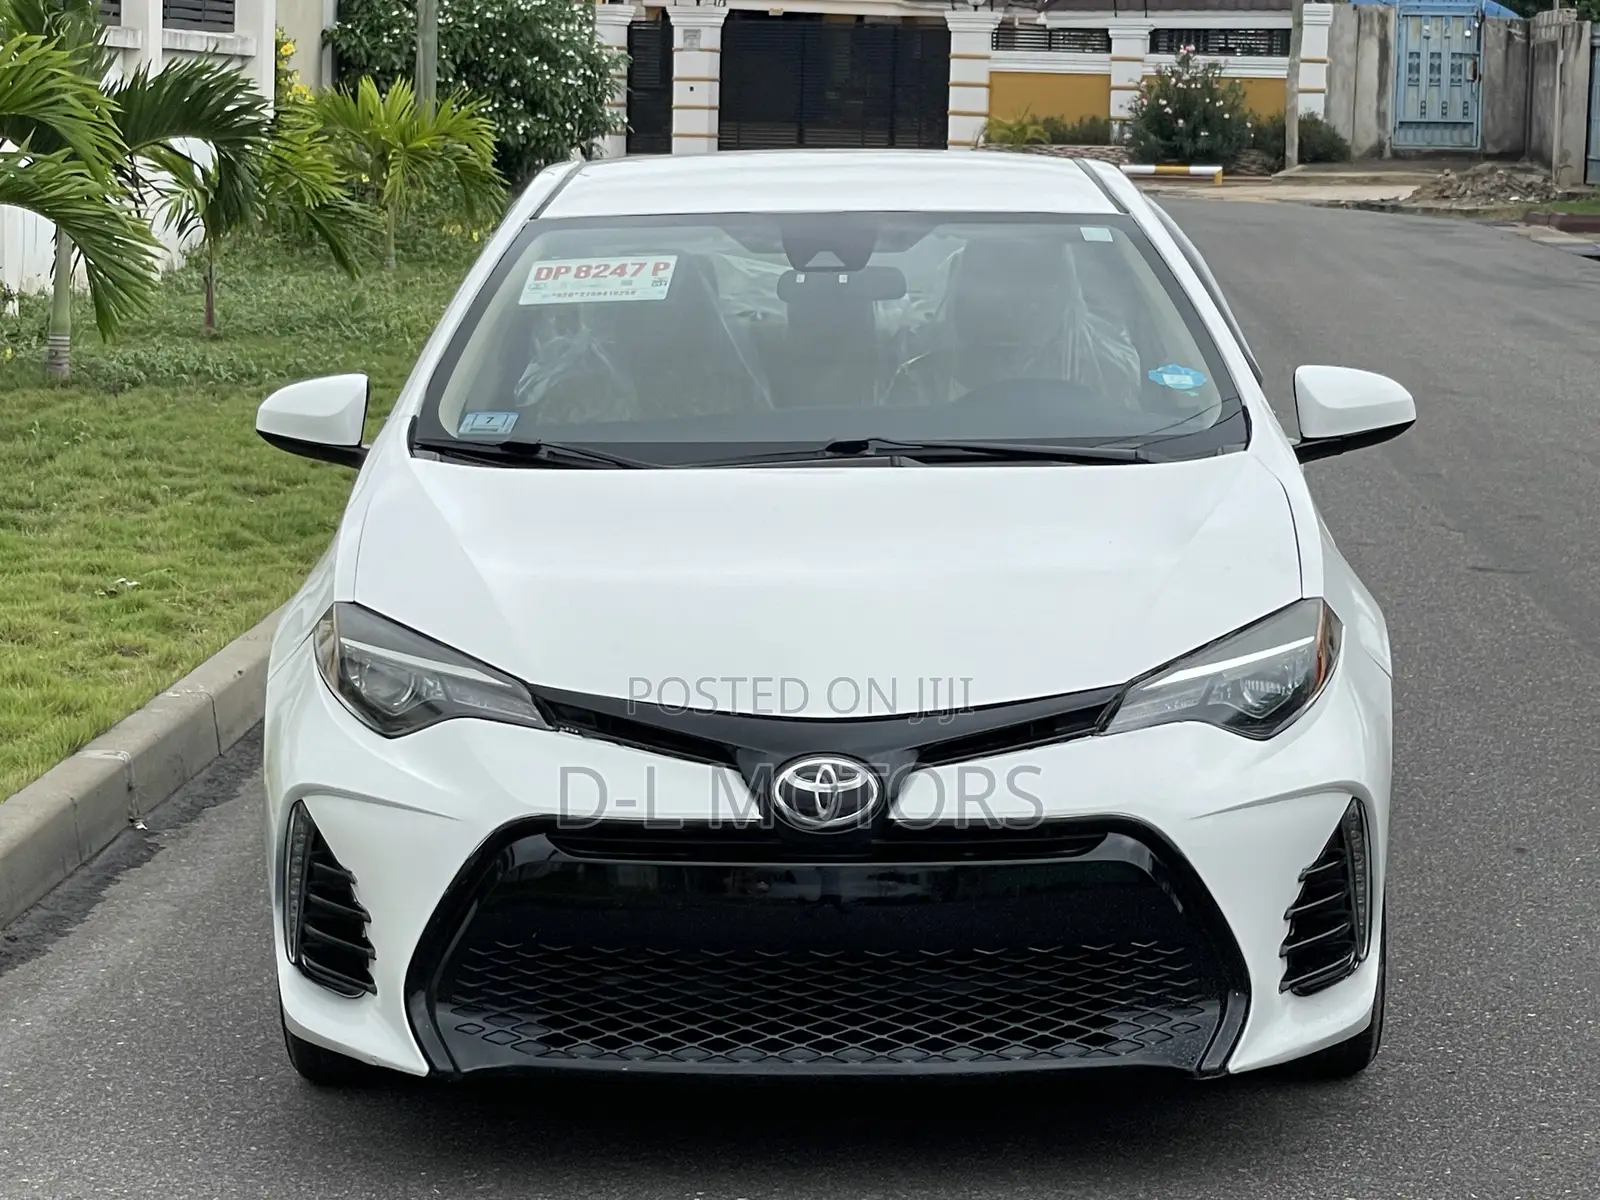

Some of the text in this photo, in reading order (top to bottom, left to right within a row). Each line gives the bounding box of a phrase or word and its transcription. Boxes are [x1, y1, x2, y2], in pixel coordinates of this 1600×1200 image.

[534, 262, 671, 281] DP 8247 P
[486, 416, 495, 424] 7
